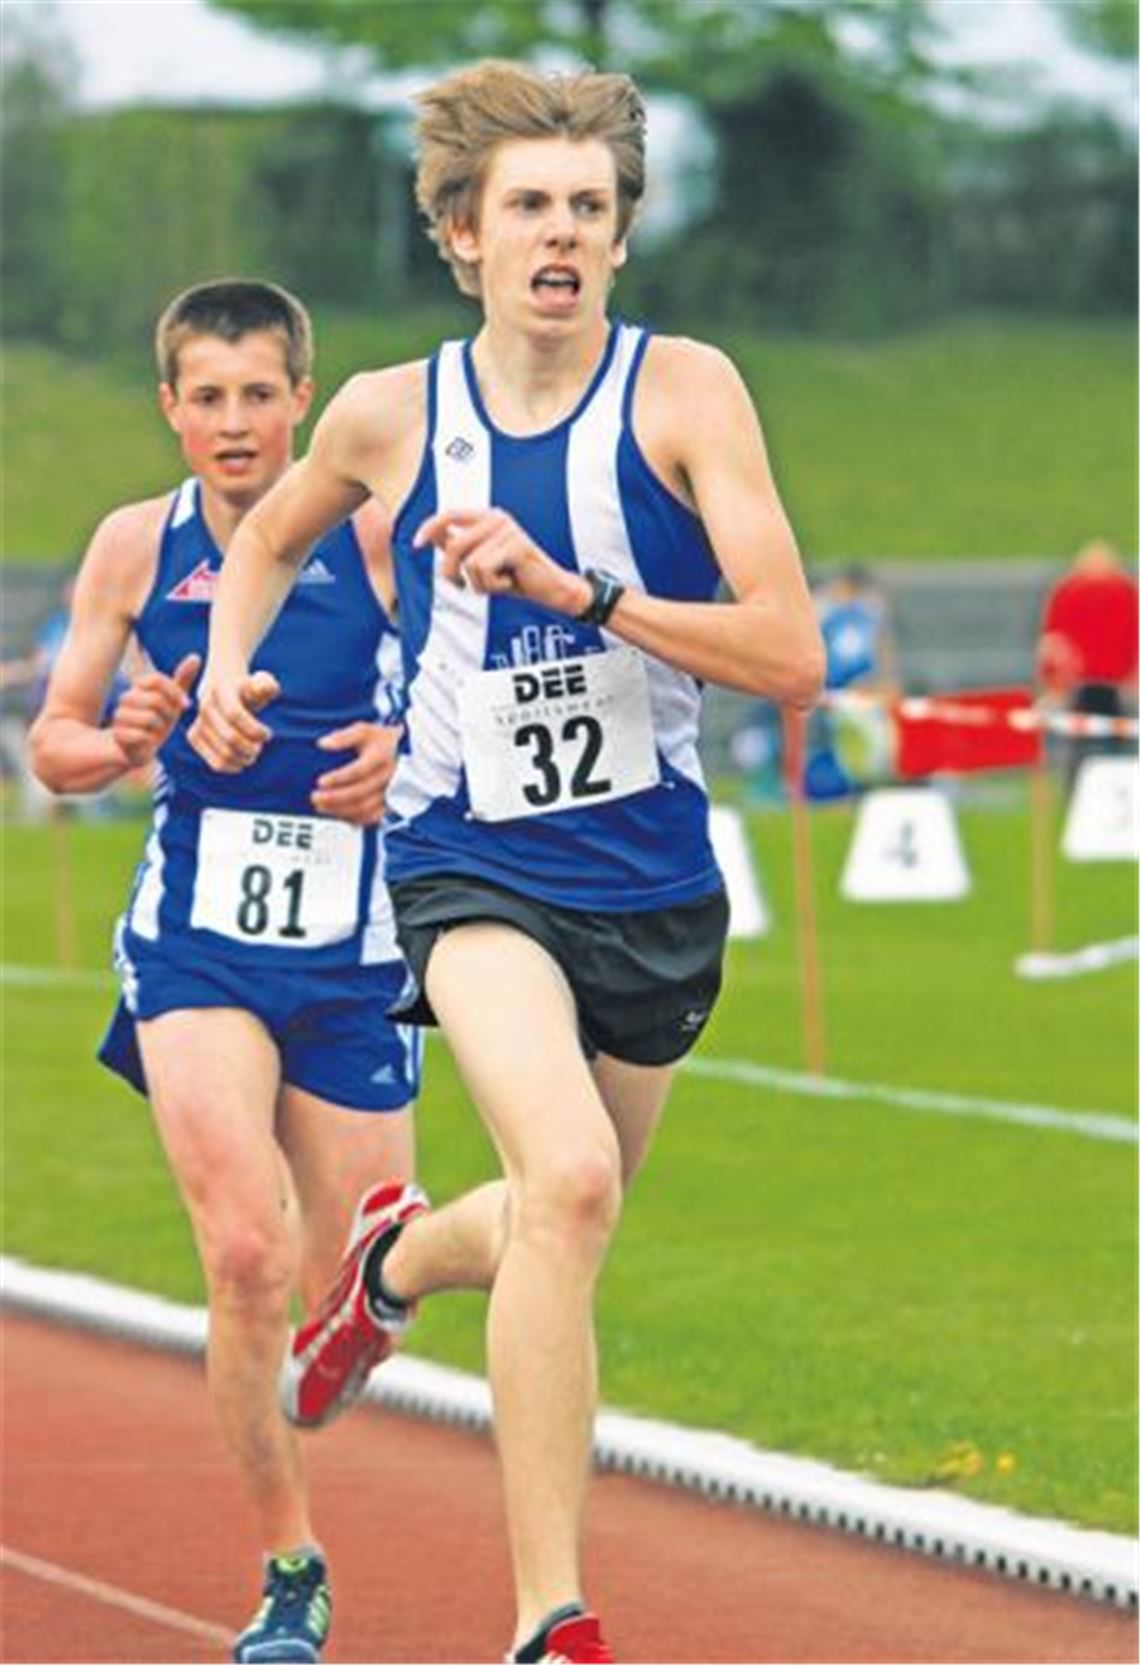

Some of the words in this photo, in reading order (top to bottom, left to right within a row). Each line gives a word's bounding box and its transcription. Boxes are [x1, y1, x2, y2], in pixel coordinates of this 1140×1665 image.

[513, 665, 587, 703] DEE
[514, 715, 612, 807] 32
[252, 818, 313, 849] DEE
[237, 864, 306, 938] 81
